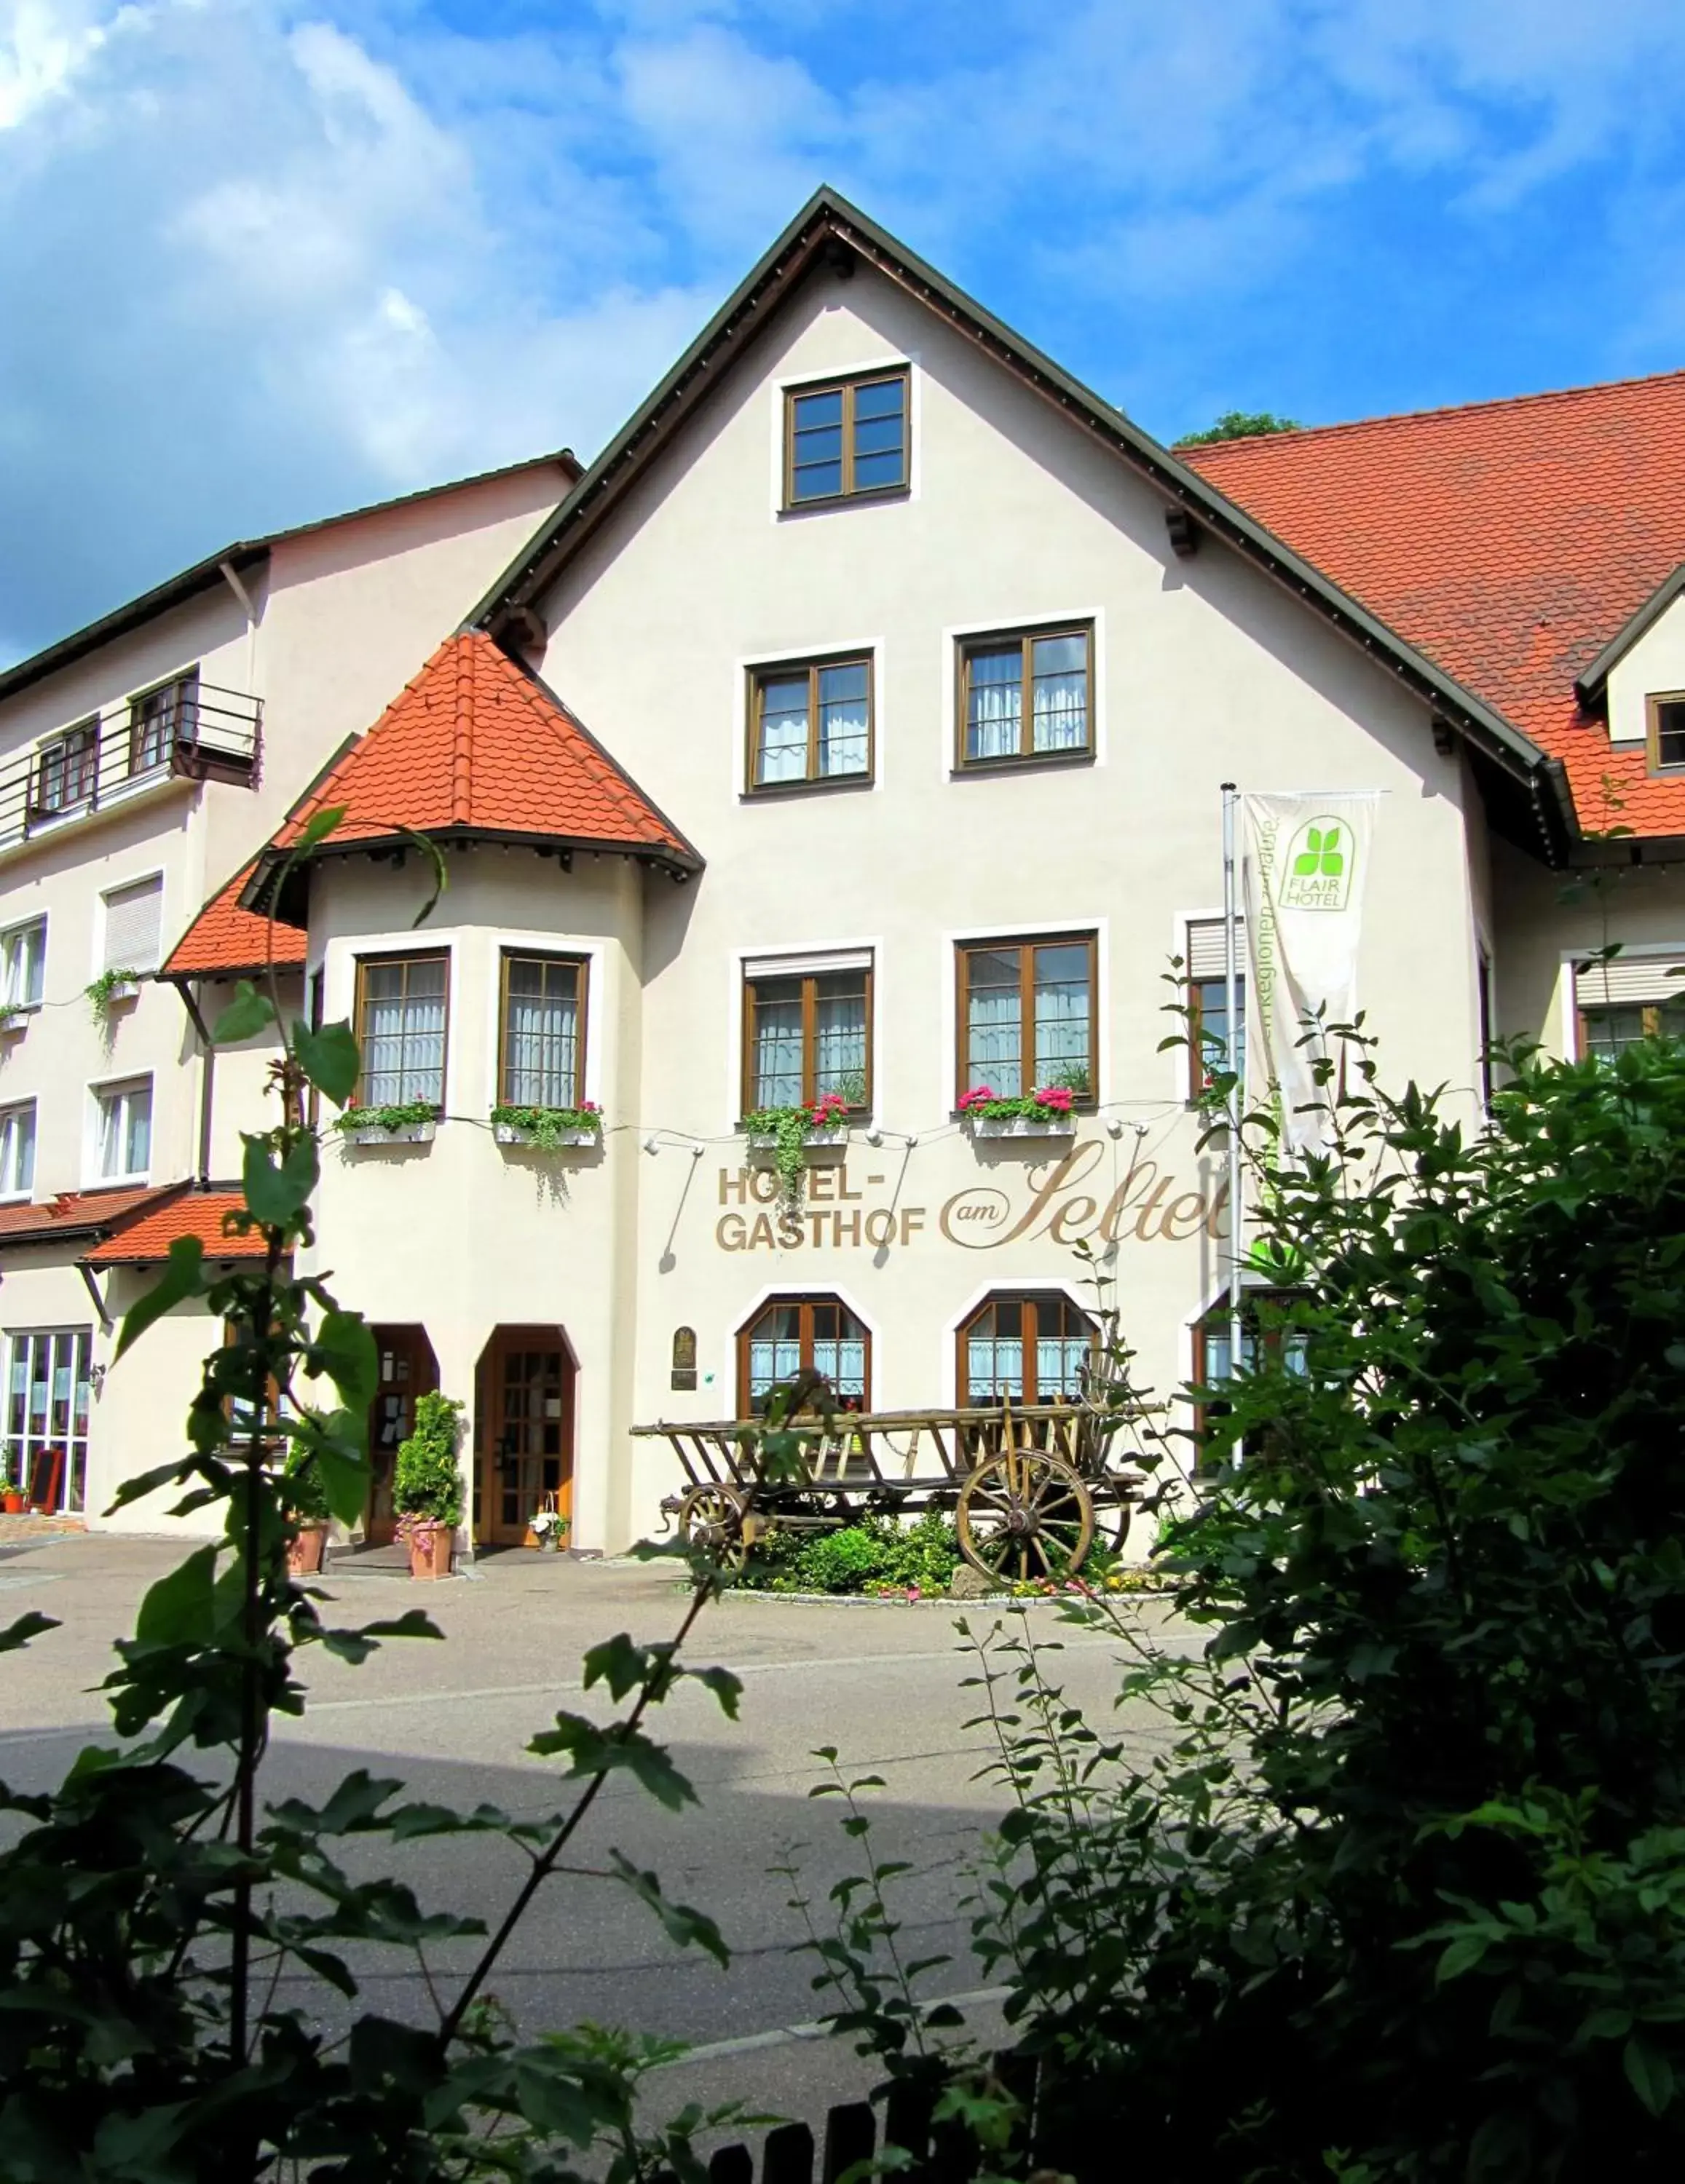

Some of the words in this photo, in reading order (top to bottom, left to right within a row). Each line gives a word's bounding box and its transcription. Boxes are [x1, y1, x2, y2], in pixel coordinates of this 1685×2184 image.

[1289, 877, 1340, 893] FLAIR
[1286, 892, 1340, 906] HOTEL
[715, 1207, 926, 1252] GASTHOF
[956, 1203, 1000, 1221] am
